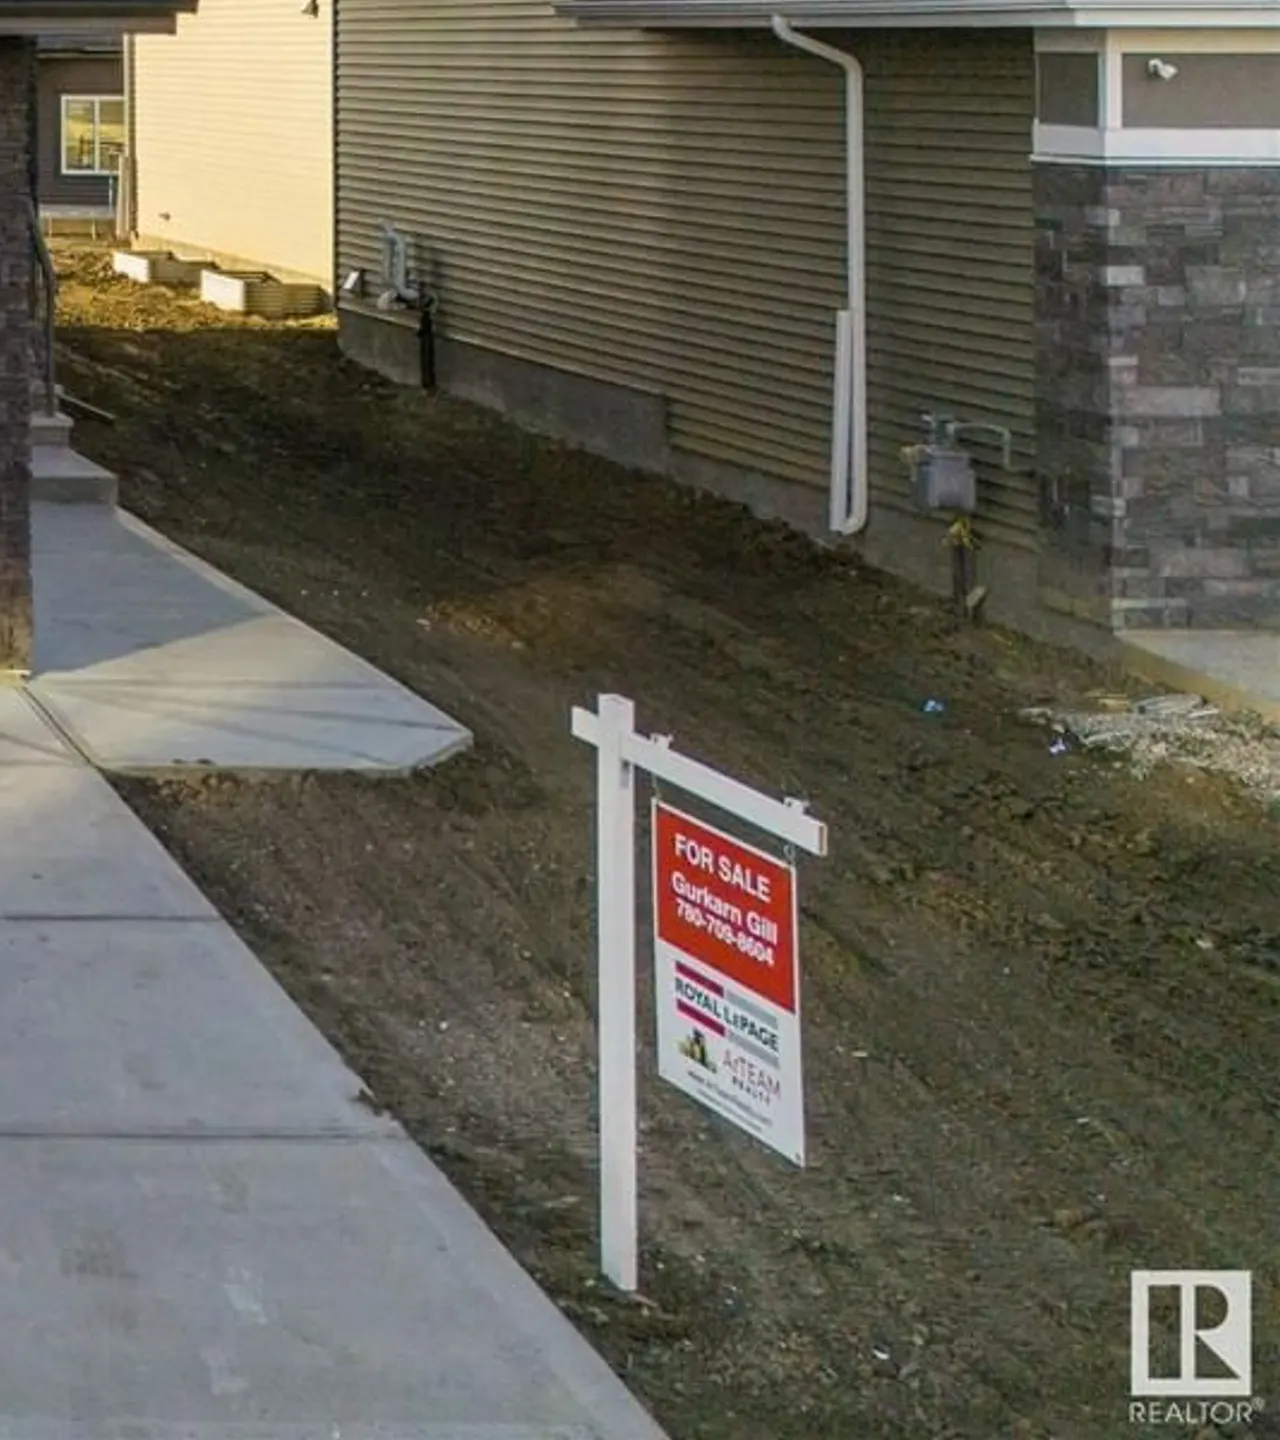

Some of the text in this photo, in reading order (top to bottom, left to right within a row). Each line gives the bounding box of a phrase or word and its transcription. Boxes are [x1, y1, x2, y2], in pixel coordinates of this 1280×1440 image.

[674, 833, 771, 903] FOR SALE
[671, 871, 778, 946] Gurkarn Gill
[674, 976, 722, 1019] ROYAL
